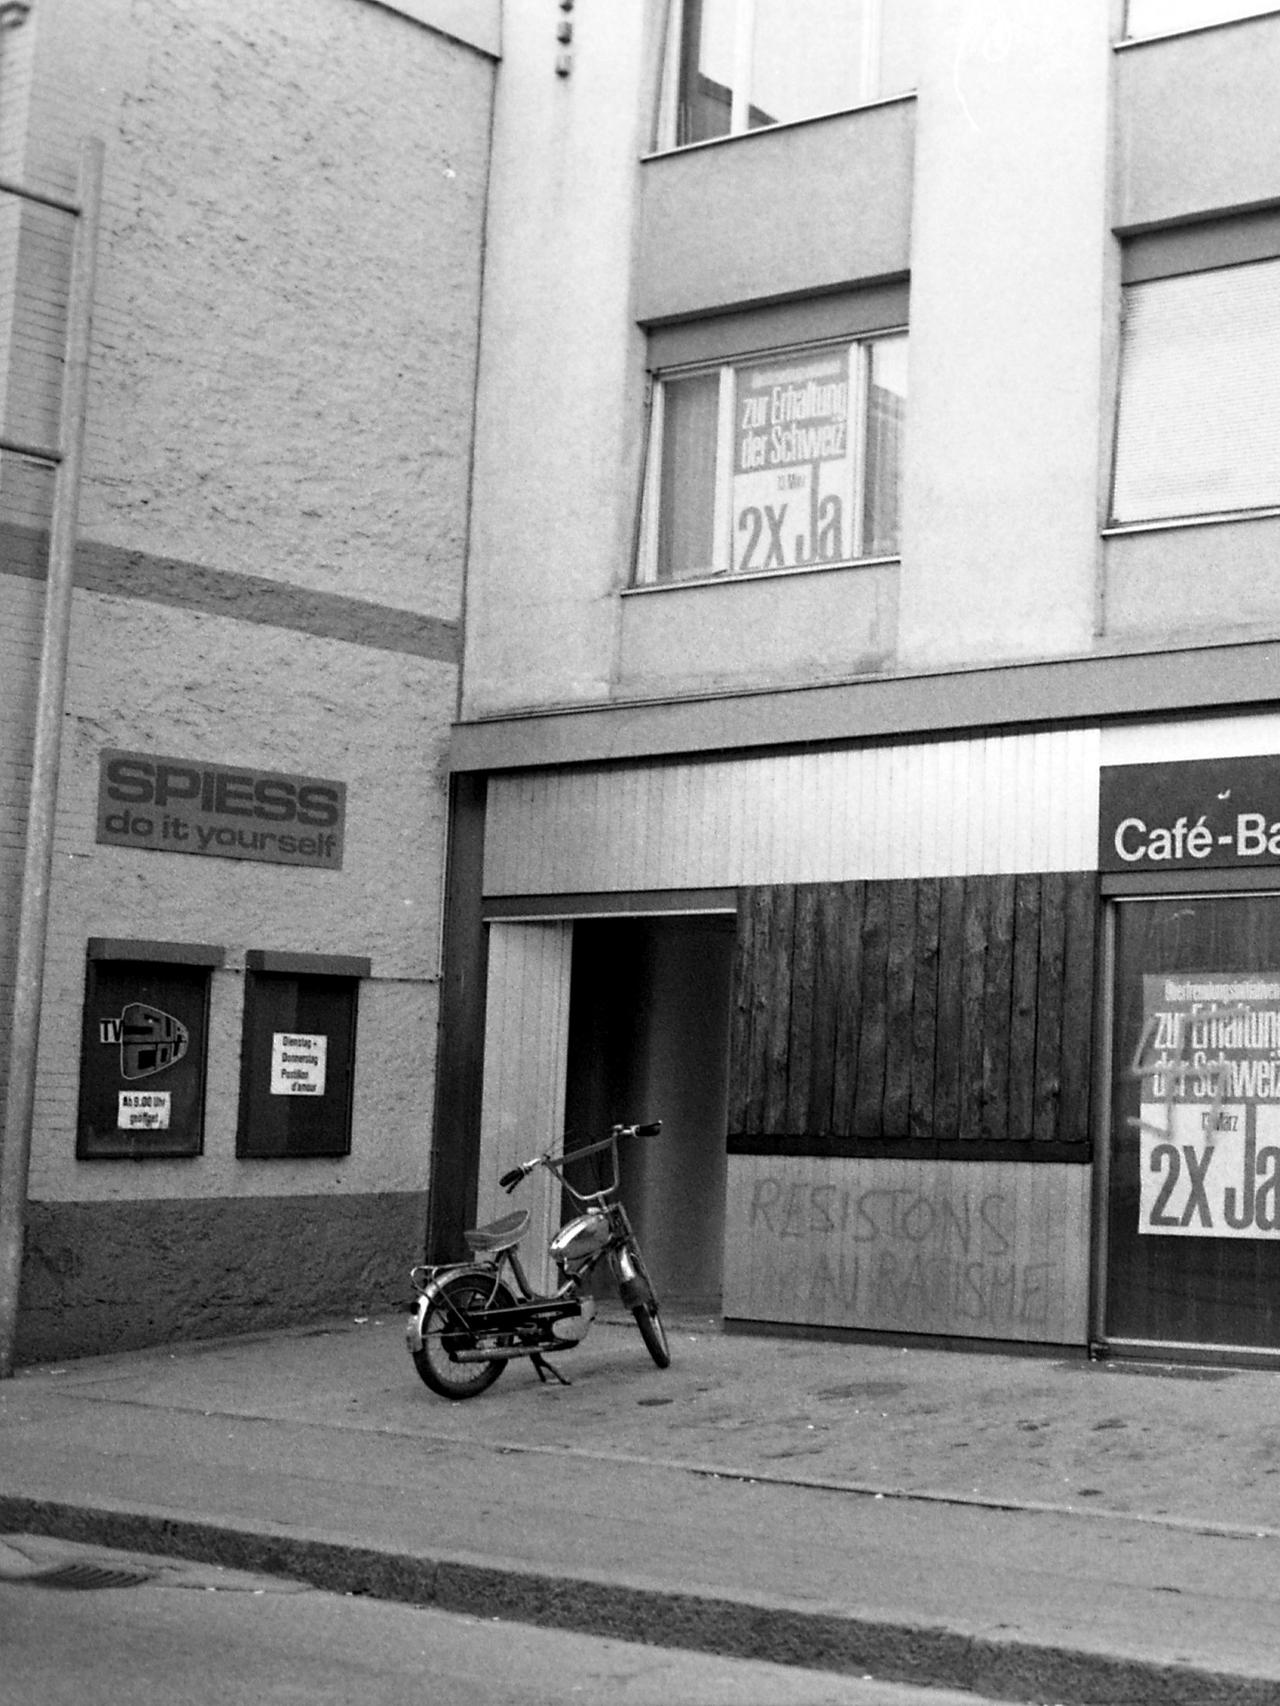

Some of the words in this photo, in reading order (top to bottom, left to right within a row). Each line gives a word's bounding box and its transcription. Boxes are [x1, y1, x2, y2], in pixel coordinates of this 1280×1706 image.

[742, 396, 768, 429] zur
[771, 381, 846, 425] Erhaltung
[741, 431, 768, 469] der
[771, 418, 846, 464] Schweiz
[795, 462, 842, 565] Ja
[107, 759, 340, 828] SPIESS
[104, 809, 154, 837] do
[161, 814, 190, 841] it
[195, 824, 338, 859] yourself
[101, 1019, 124, 1042] TV
[1154, 1012, 1188, 1049] zur
[750, 1177, 1010, 1257] RESISTONS
